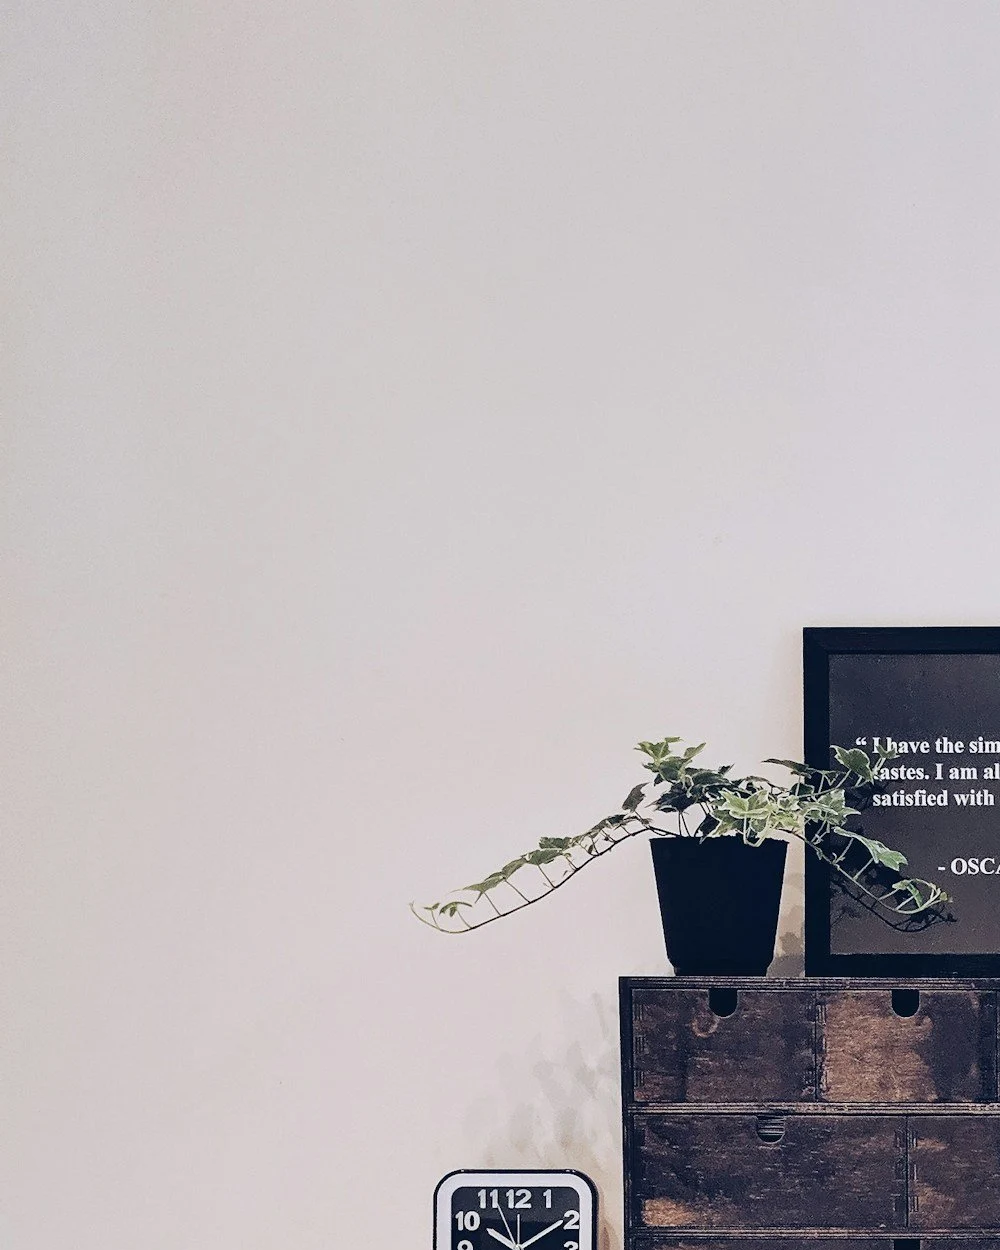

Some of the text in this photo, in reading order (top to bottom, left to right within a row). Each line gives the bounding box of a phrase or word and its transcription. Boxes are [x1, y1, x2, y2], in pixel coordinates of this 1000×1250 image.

[872, 736, 882, 754] I
[886, 736, 930, 754] have
[935, 736, 964, 754] the
[935, 763, 944, 780] I
[949, 767, 978, 780] am
[872, 788, 948, 807] satisfied
[953, 788, 994, 807] with
[477, 1188, 552, 1209] 11 12 1
[455, 1210, 481, 1231] 10
[563, 1210, 580, 1231] 2
